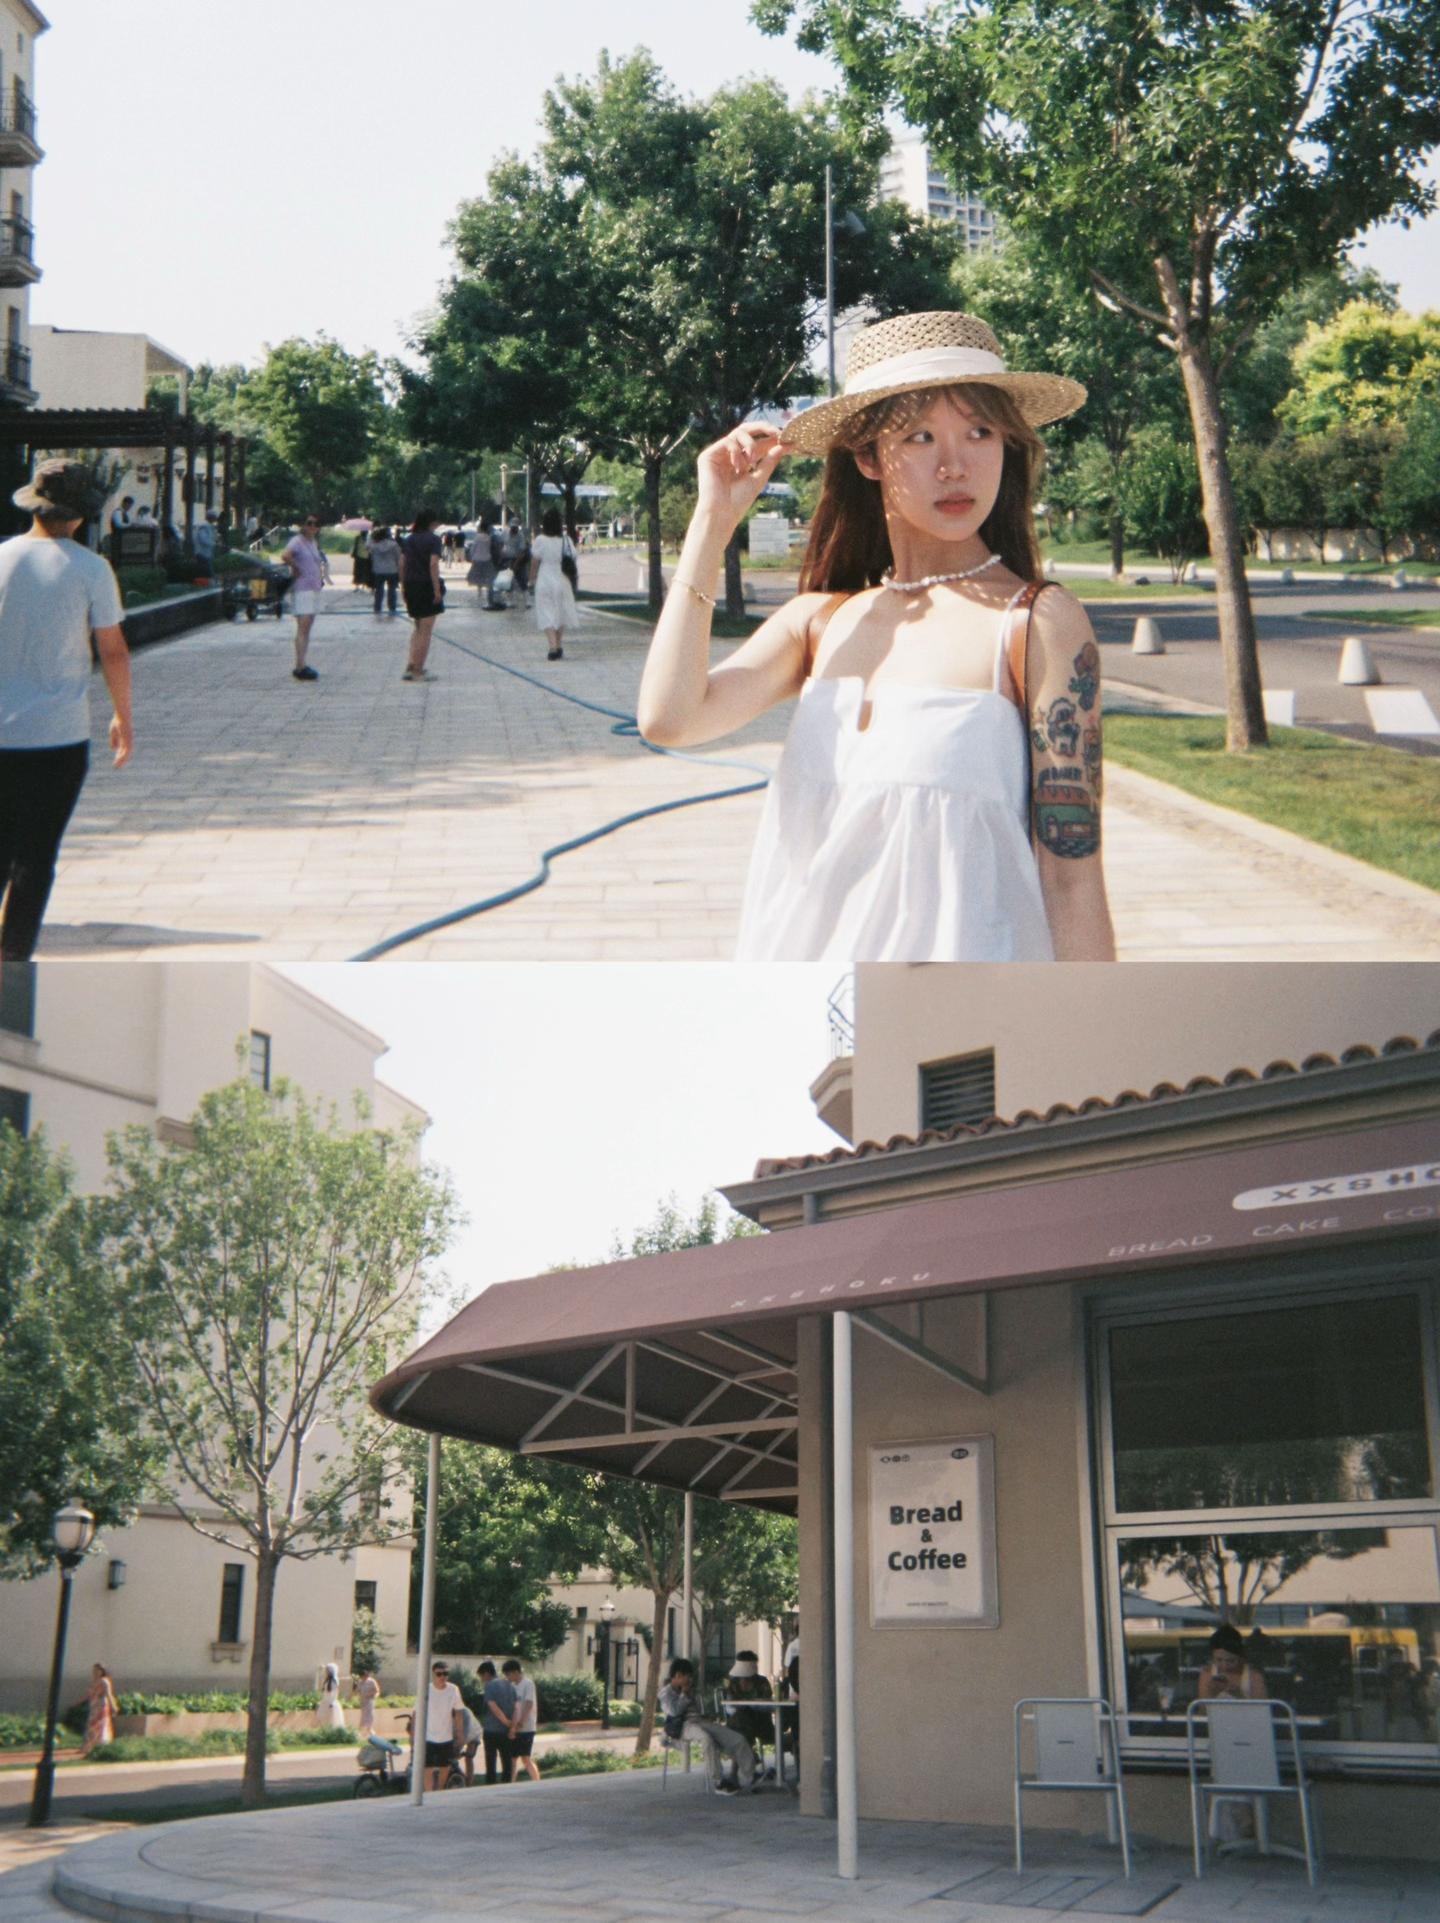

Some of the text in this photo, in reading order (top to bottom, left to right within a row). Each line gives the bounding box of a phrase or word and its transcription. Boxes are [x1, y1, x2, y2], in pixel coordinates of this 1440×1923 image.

[1108, 1205, 1440, 1257] BREAD CAKE CO
[889, 1499, 963, 1525] Bread
[920, 1528, 933, 1543] &
[887, 1547, 967, 1571] Coffee
